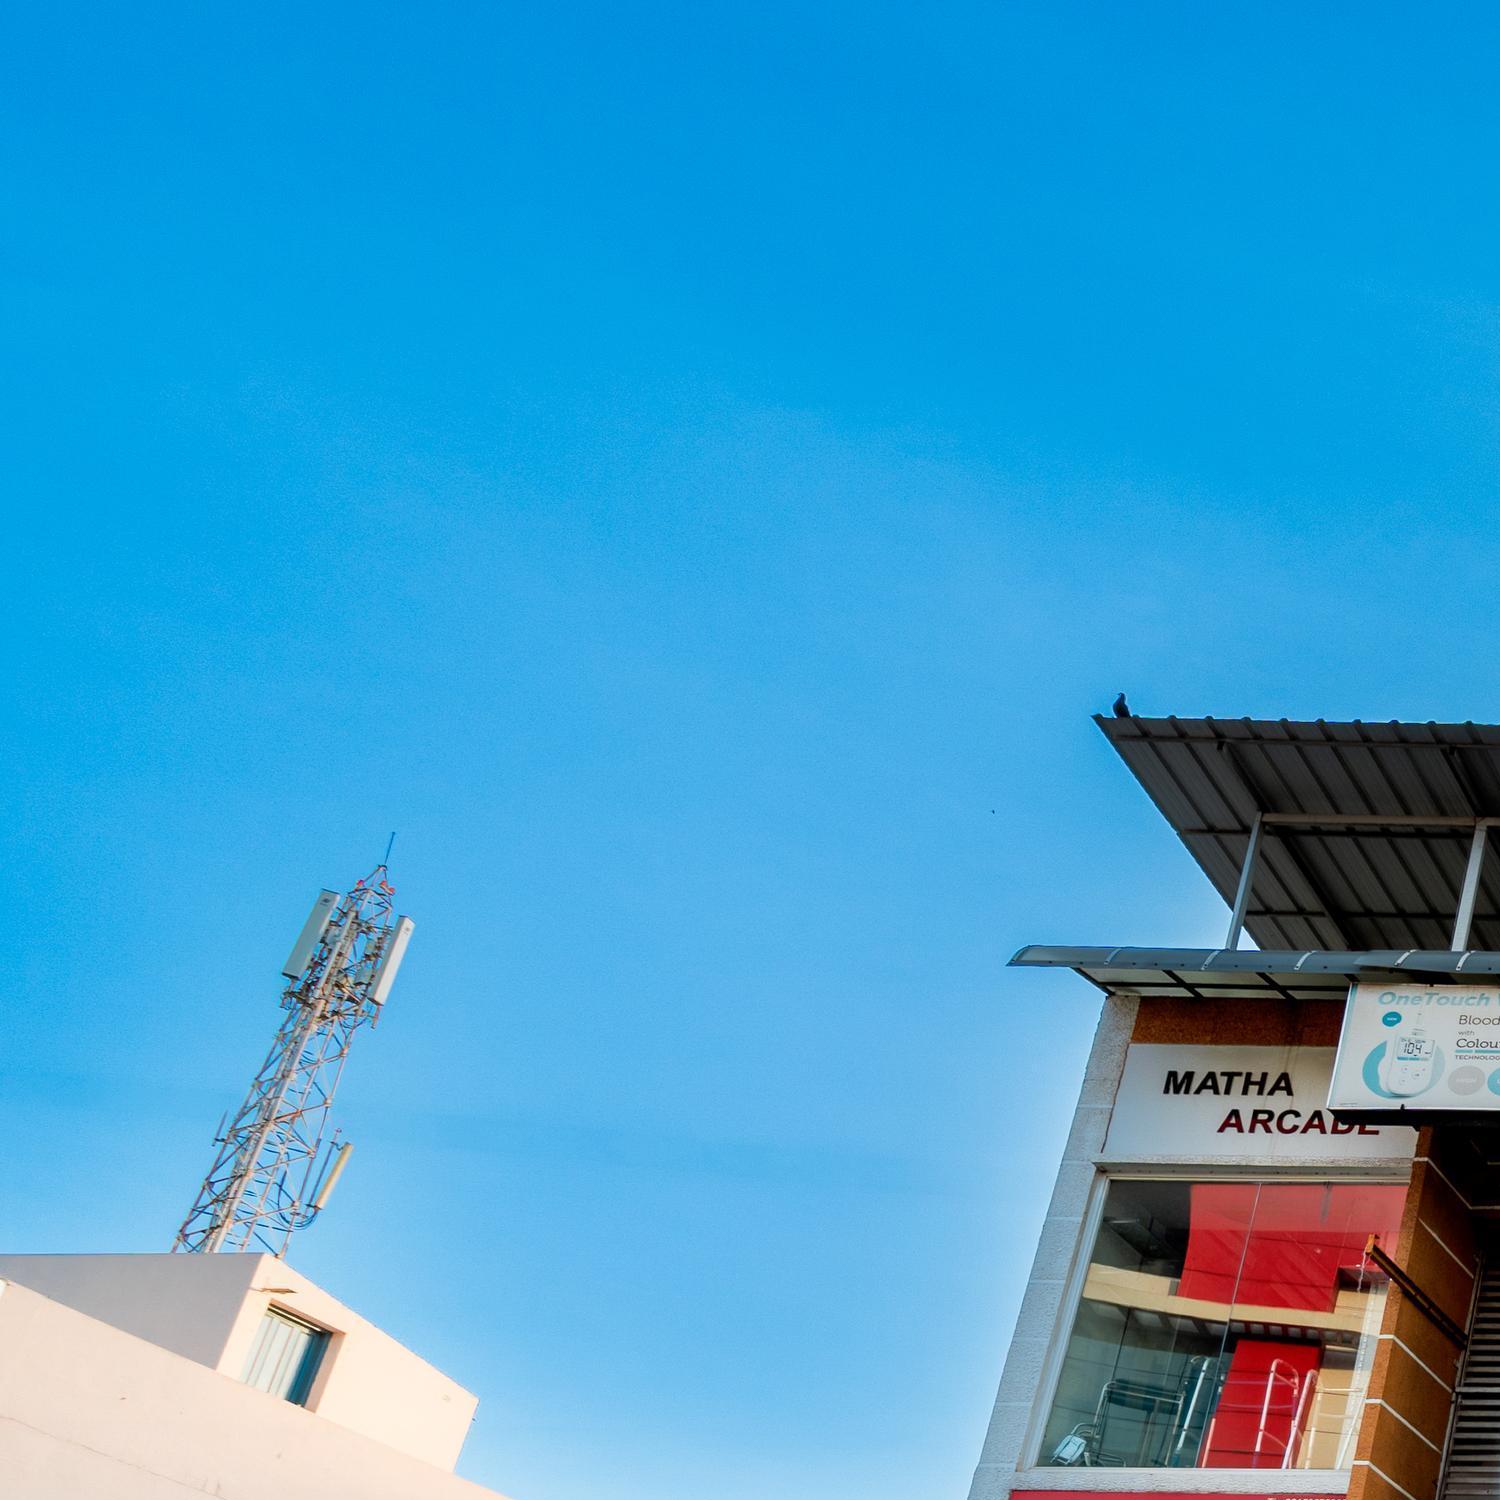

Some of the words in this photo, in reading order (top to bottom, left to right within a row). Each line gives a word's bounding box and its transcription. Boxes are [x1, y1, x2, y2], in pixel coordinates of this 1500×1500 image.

[1377, 990, 1491, 1009] OneTouch
[1458, 1014, 1500, 1027] Blood
[1163, 1070, 1294, 1097] MATHA
